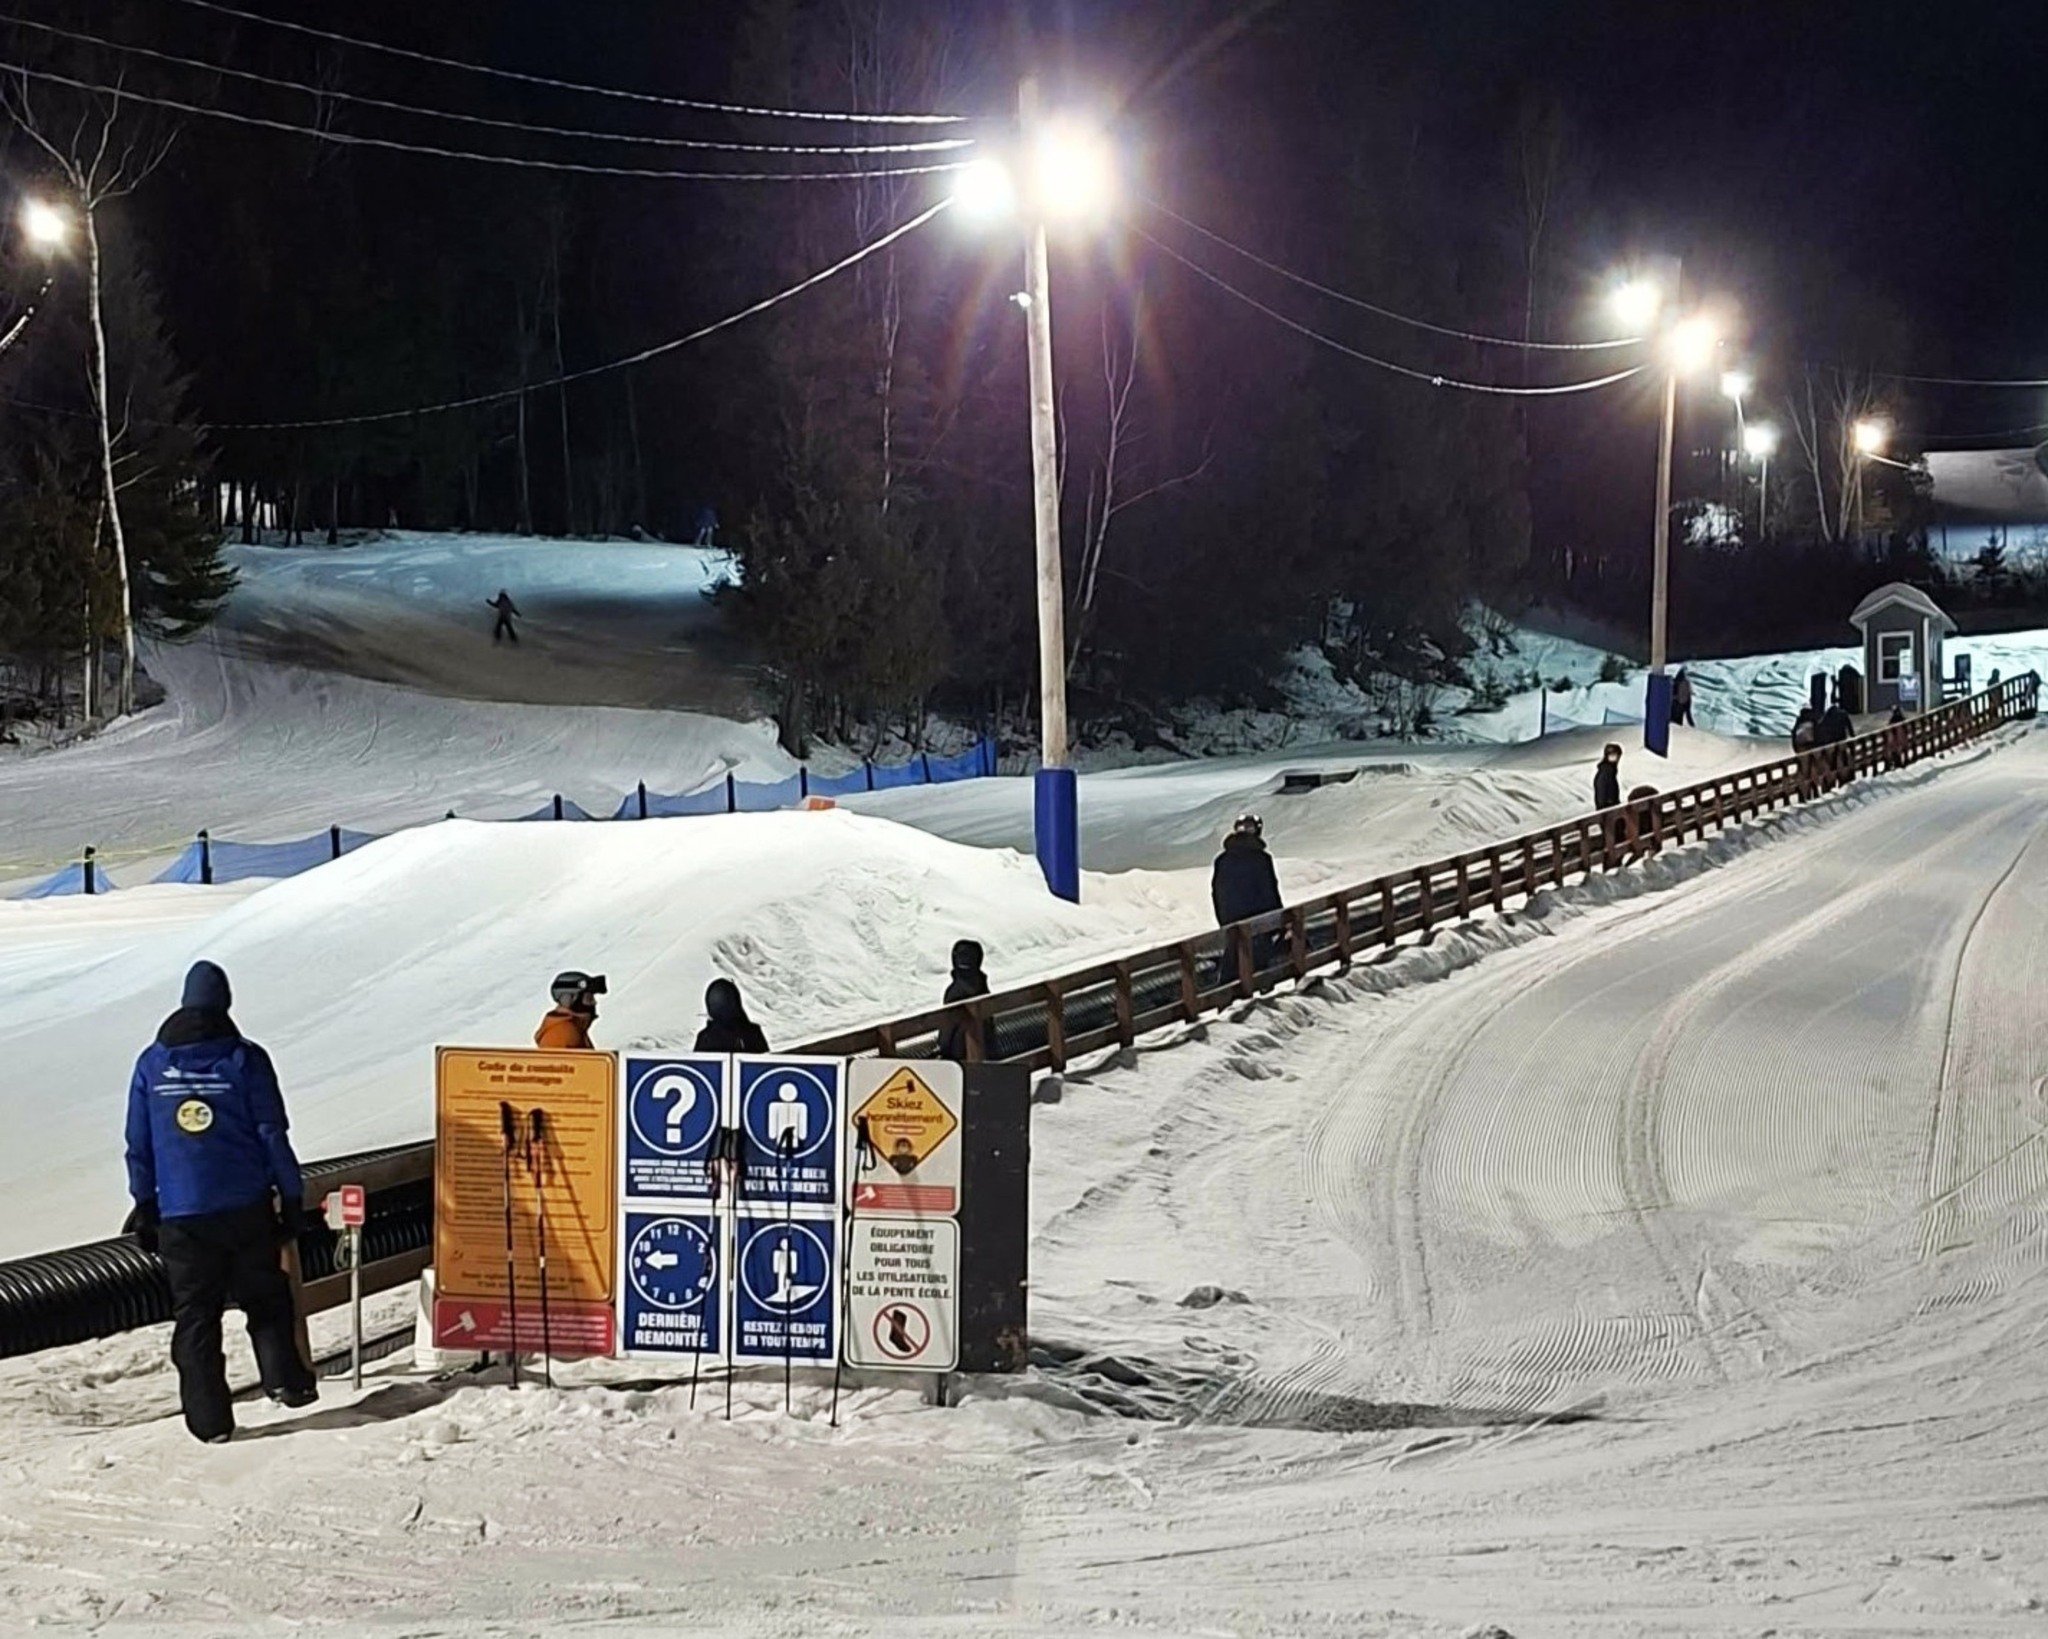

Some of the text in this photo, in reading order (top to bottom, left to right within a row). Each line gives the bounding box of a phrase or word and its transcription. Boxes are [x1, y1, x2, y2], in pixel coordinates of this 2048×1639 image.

[886, 1097, 923, 1110] Skiez
[747, 1165, 800, 1179] ATTACZ
[744, 1179, 765, 1191] VOS
[650, 1229, 662, 1240] 11
[667, 1224, 680, 1236] 12
[686, 1229, 693, 1241] 1
[870, 1227, 935, 1239] ÉQUIPEMENT
[638, 1241, 651, 1252] 10
[697, 1242, 705, 1253] 2
[870, 1242, 935, 1255] OBLIGATOIRE
[874, 1257, 931, 1269] POUR TOUS
[856, 1271, 948, 1284] LES UTILISATEURS
[652, 1287, 660, 1299] 7
[852, 1285, 865, 1296] DE
[868, 1286, 880, 1296] LA
[883, 1287, 915, 1298] PENTE
[743, 1320, 782, 1333] RESTEZ
[635, 1329, 709, 1348] REMONTÉE
[743, 1335, 826, 1349] EN TOUT TEMPS
